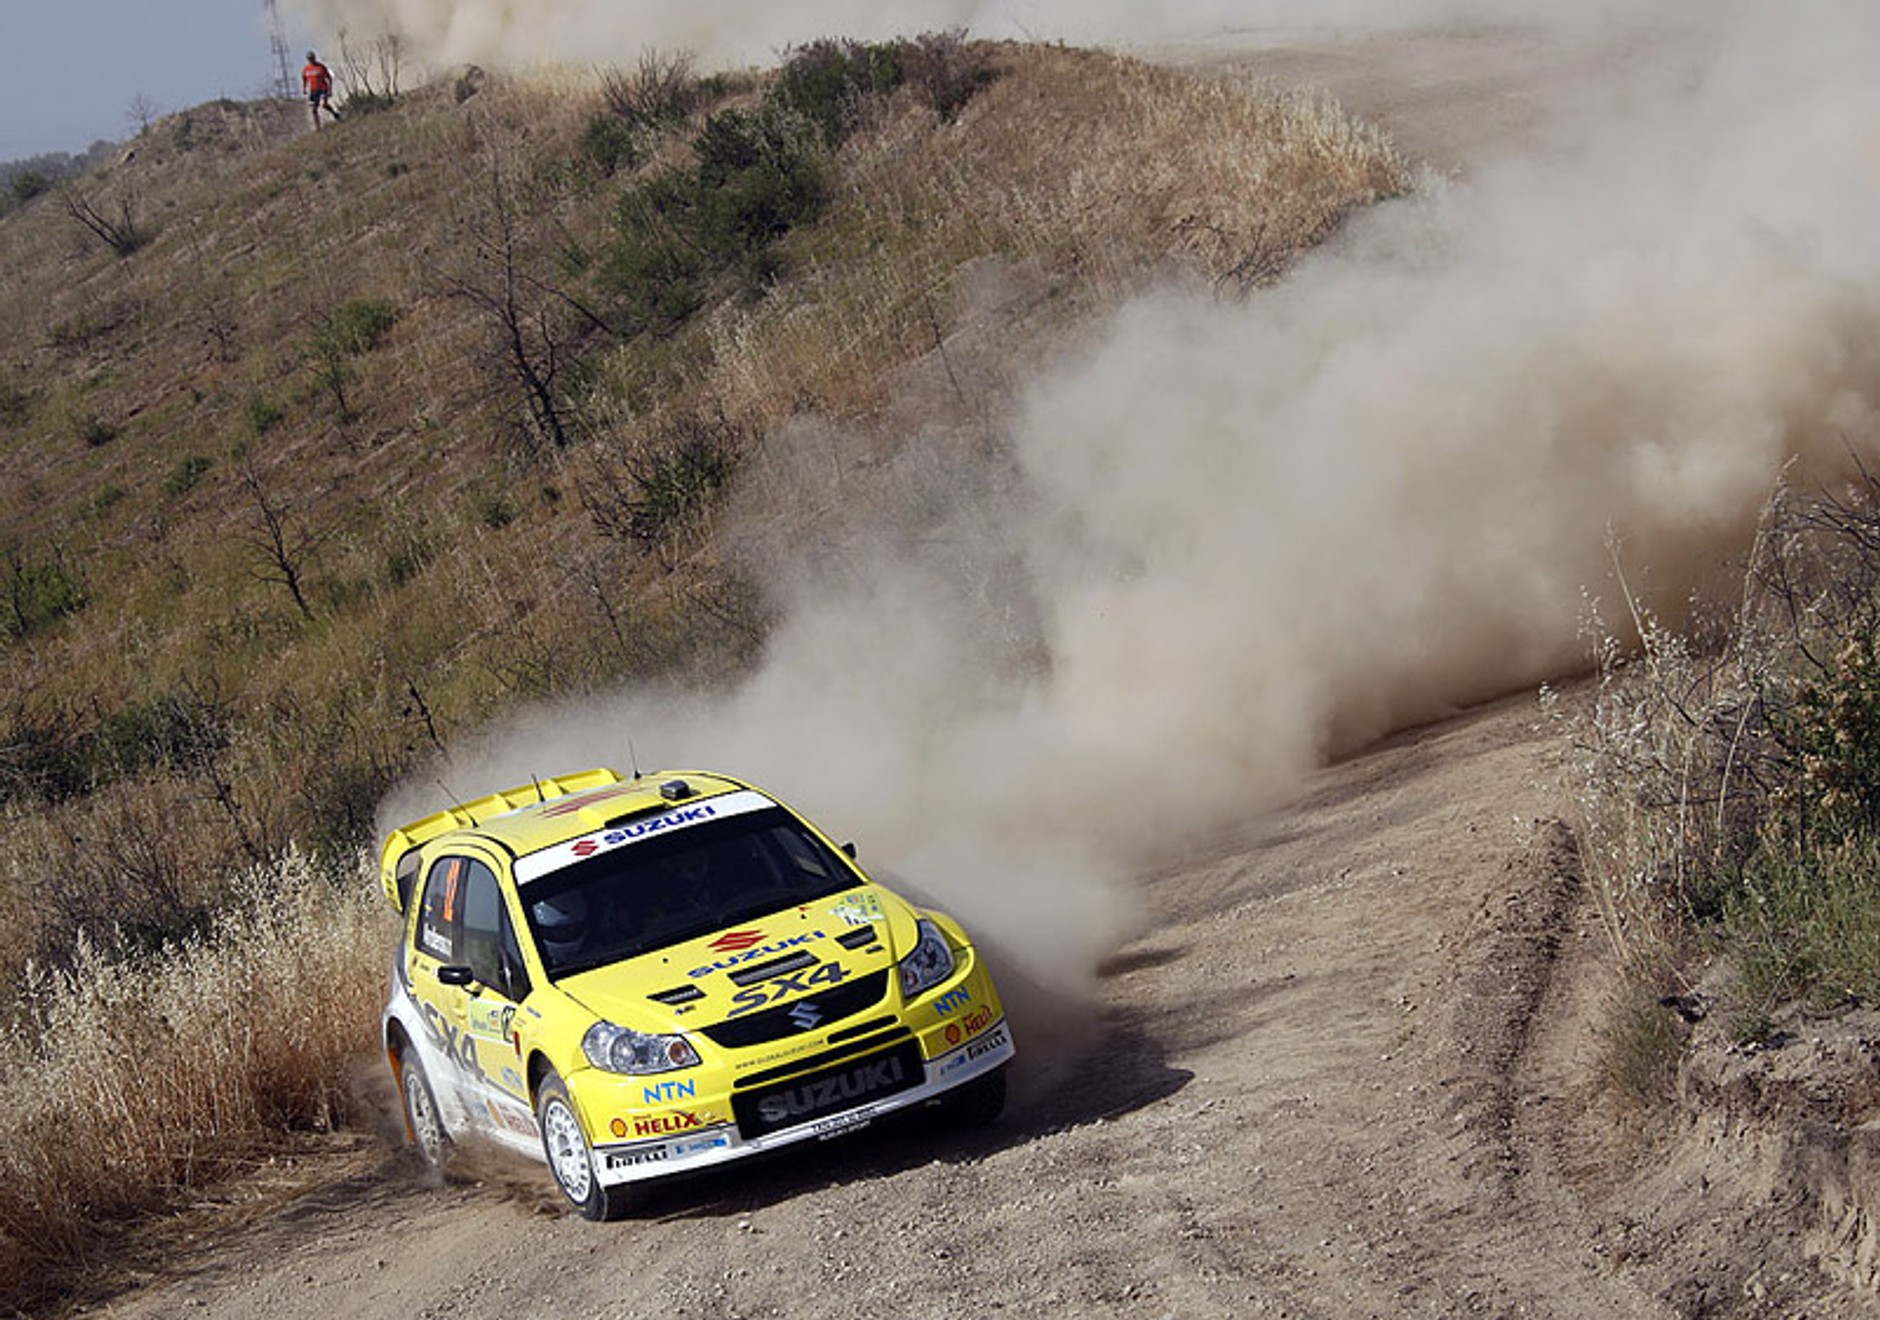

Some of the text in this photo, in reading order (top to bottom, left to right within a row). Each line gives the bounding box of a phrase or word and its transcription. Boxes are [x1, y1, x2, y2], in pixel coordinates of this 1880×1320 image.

[603, 805, 716, 845] SUZUKI
[686, 930, 826, 978] SUZUKI
[727, 961, 852, 1018] SX4
[933, 984, 971, 1016] NTN
[644, 1079, 695, 1103] NTN
[757, 1055, 904, 1122] SUZUKI
[634, 1111, 701, 1136] HELIX
[606, 1144, 668, 1170] PIRELLI
